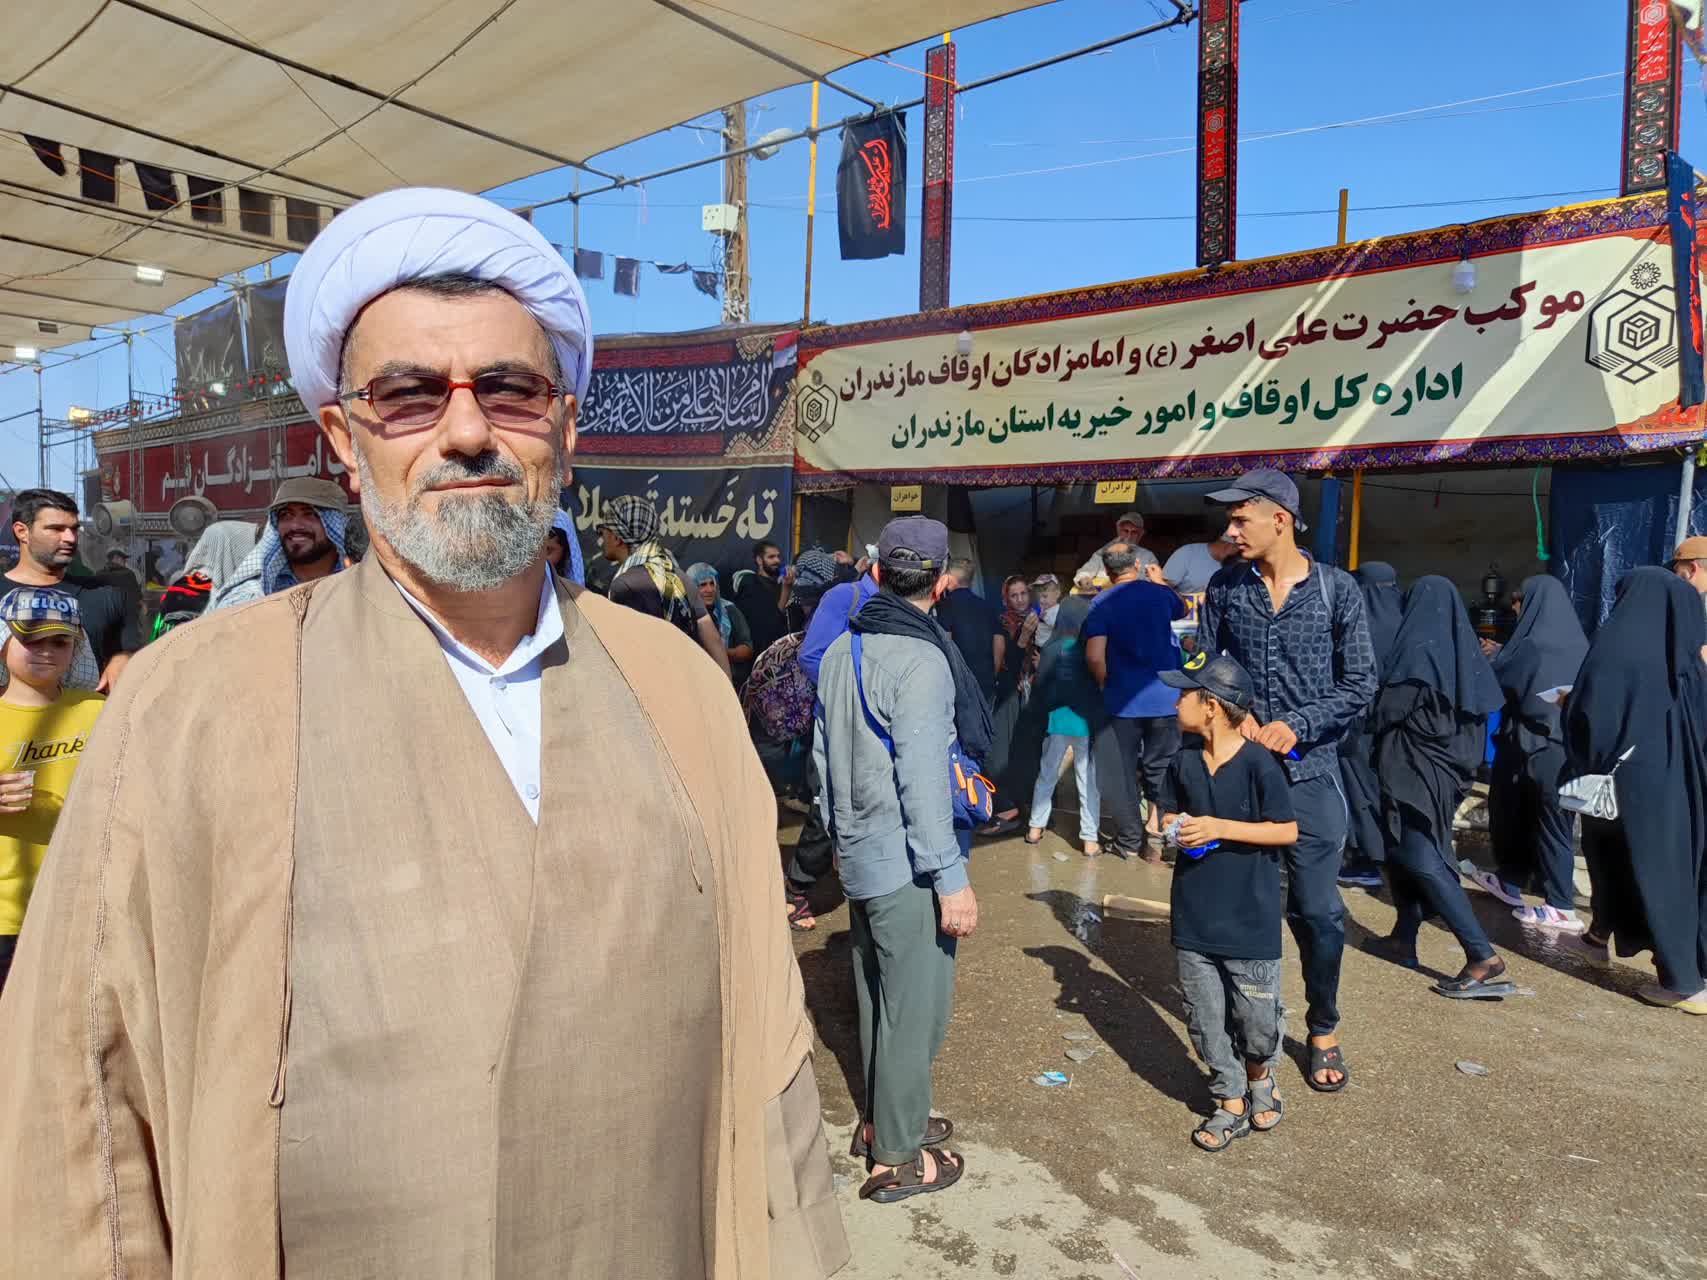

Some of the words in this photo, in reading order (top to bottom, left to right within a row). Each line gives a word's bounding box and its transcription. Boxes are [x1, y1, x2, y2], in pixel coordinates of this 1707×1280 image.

[1333, 298, 1458, 349] حضرت
[1464, 280, 1584, 335] موکب
[1145, 341, 1177, 368] (ع)
[1180, 318, 1255, 370] اصغر
[1259, 312, 1328, 360] علی
[840, 360, 925, 402] مازندران
[928, 352, 991, 390] اوقاف
[991, 336, 1125, 387] امامزادگان
[1125, 347, 1141, 376] و
[1136, 389, 1196, 436] امور
[1222, 378, 1310, 425] اوقاف
[1314, 372, 1368, 421] کل
[1371, 362, 1463, 417] اداره
[891, 408, 985, 449] مازندران
[988, 402, 1054, 444] استان
[1199, 402, 1216, 431] و
